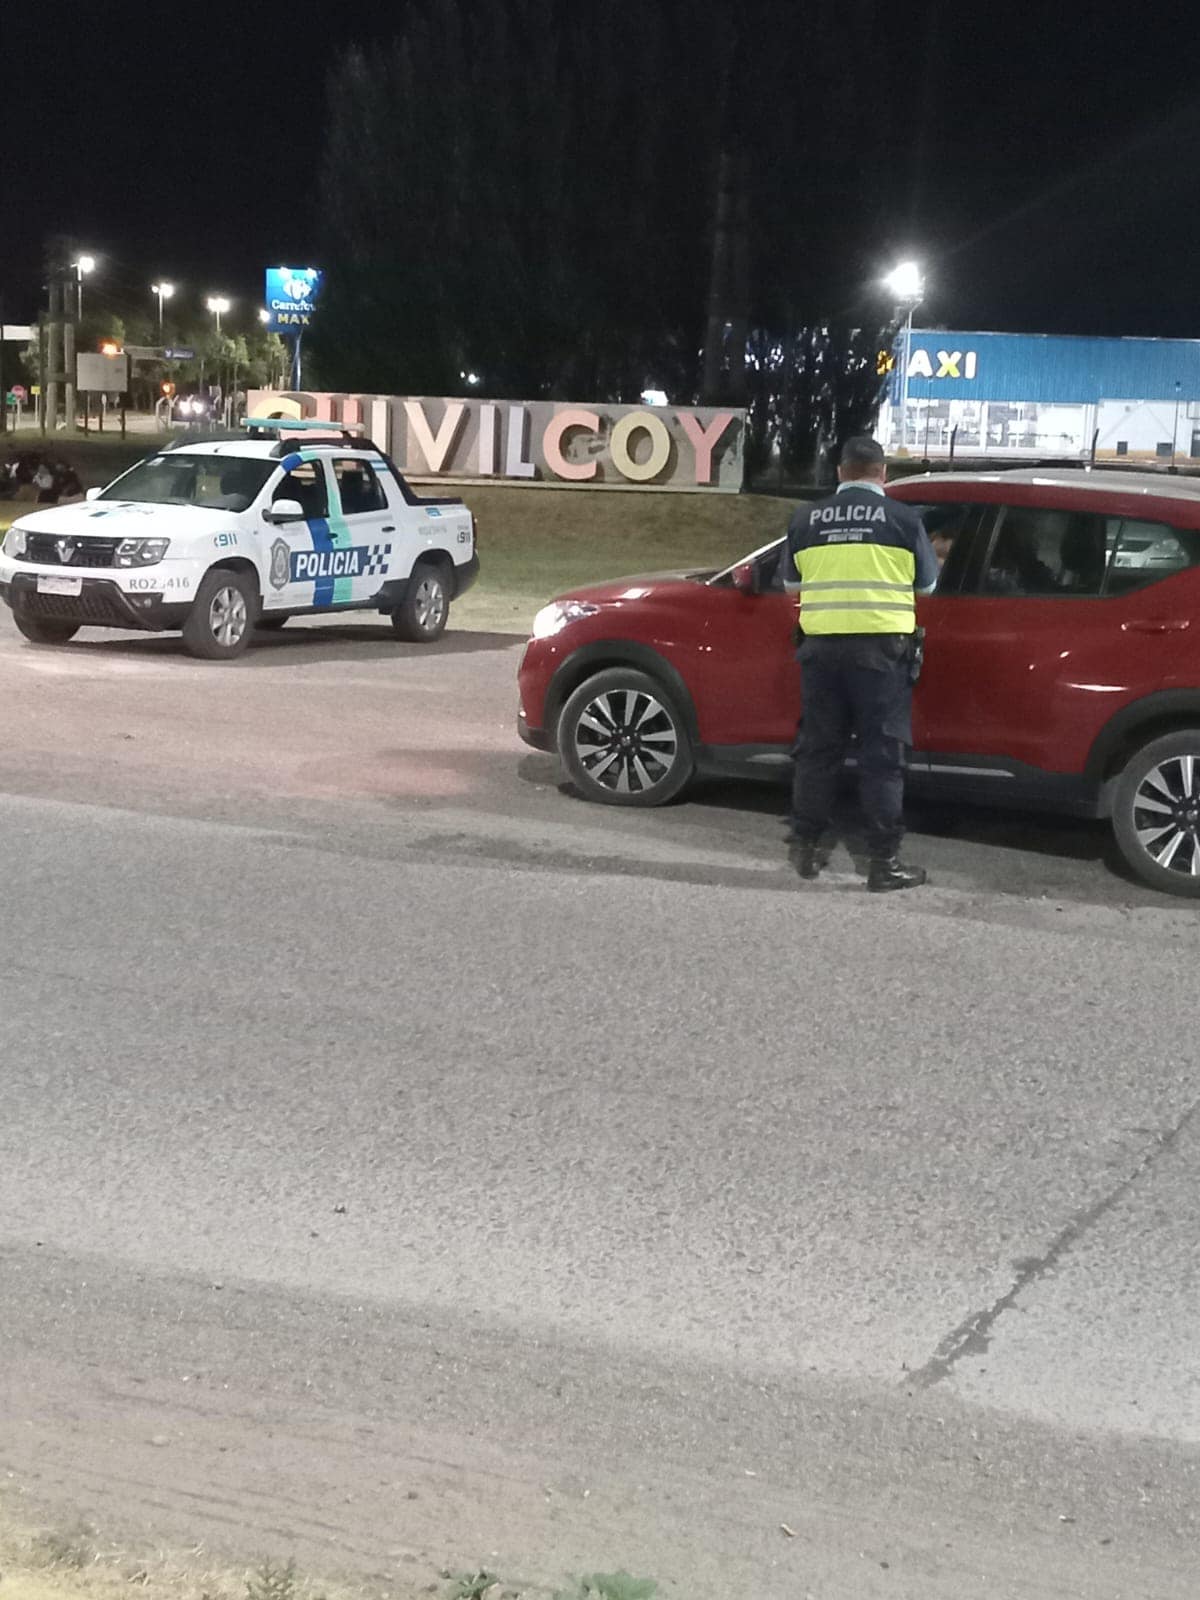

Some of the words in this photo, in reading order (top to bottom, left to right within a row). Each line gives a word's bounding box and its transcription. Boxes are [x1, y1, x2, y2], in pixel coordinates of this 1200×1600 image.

[277, 313, 310, 325] MAX
[809, 504, 887, 526] POLICIA
[218, 533, 238, 547] 911
[295, 550, 359, 578] POLICIA
